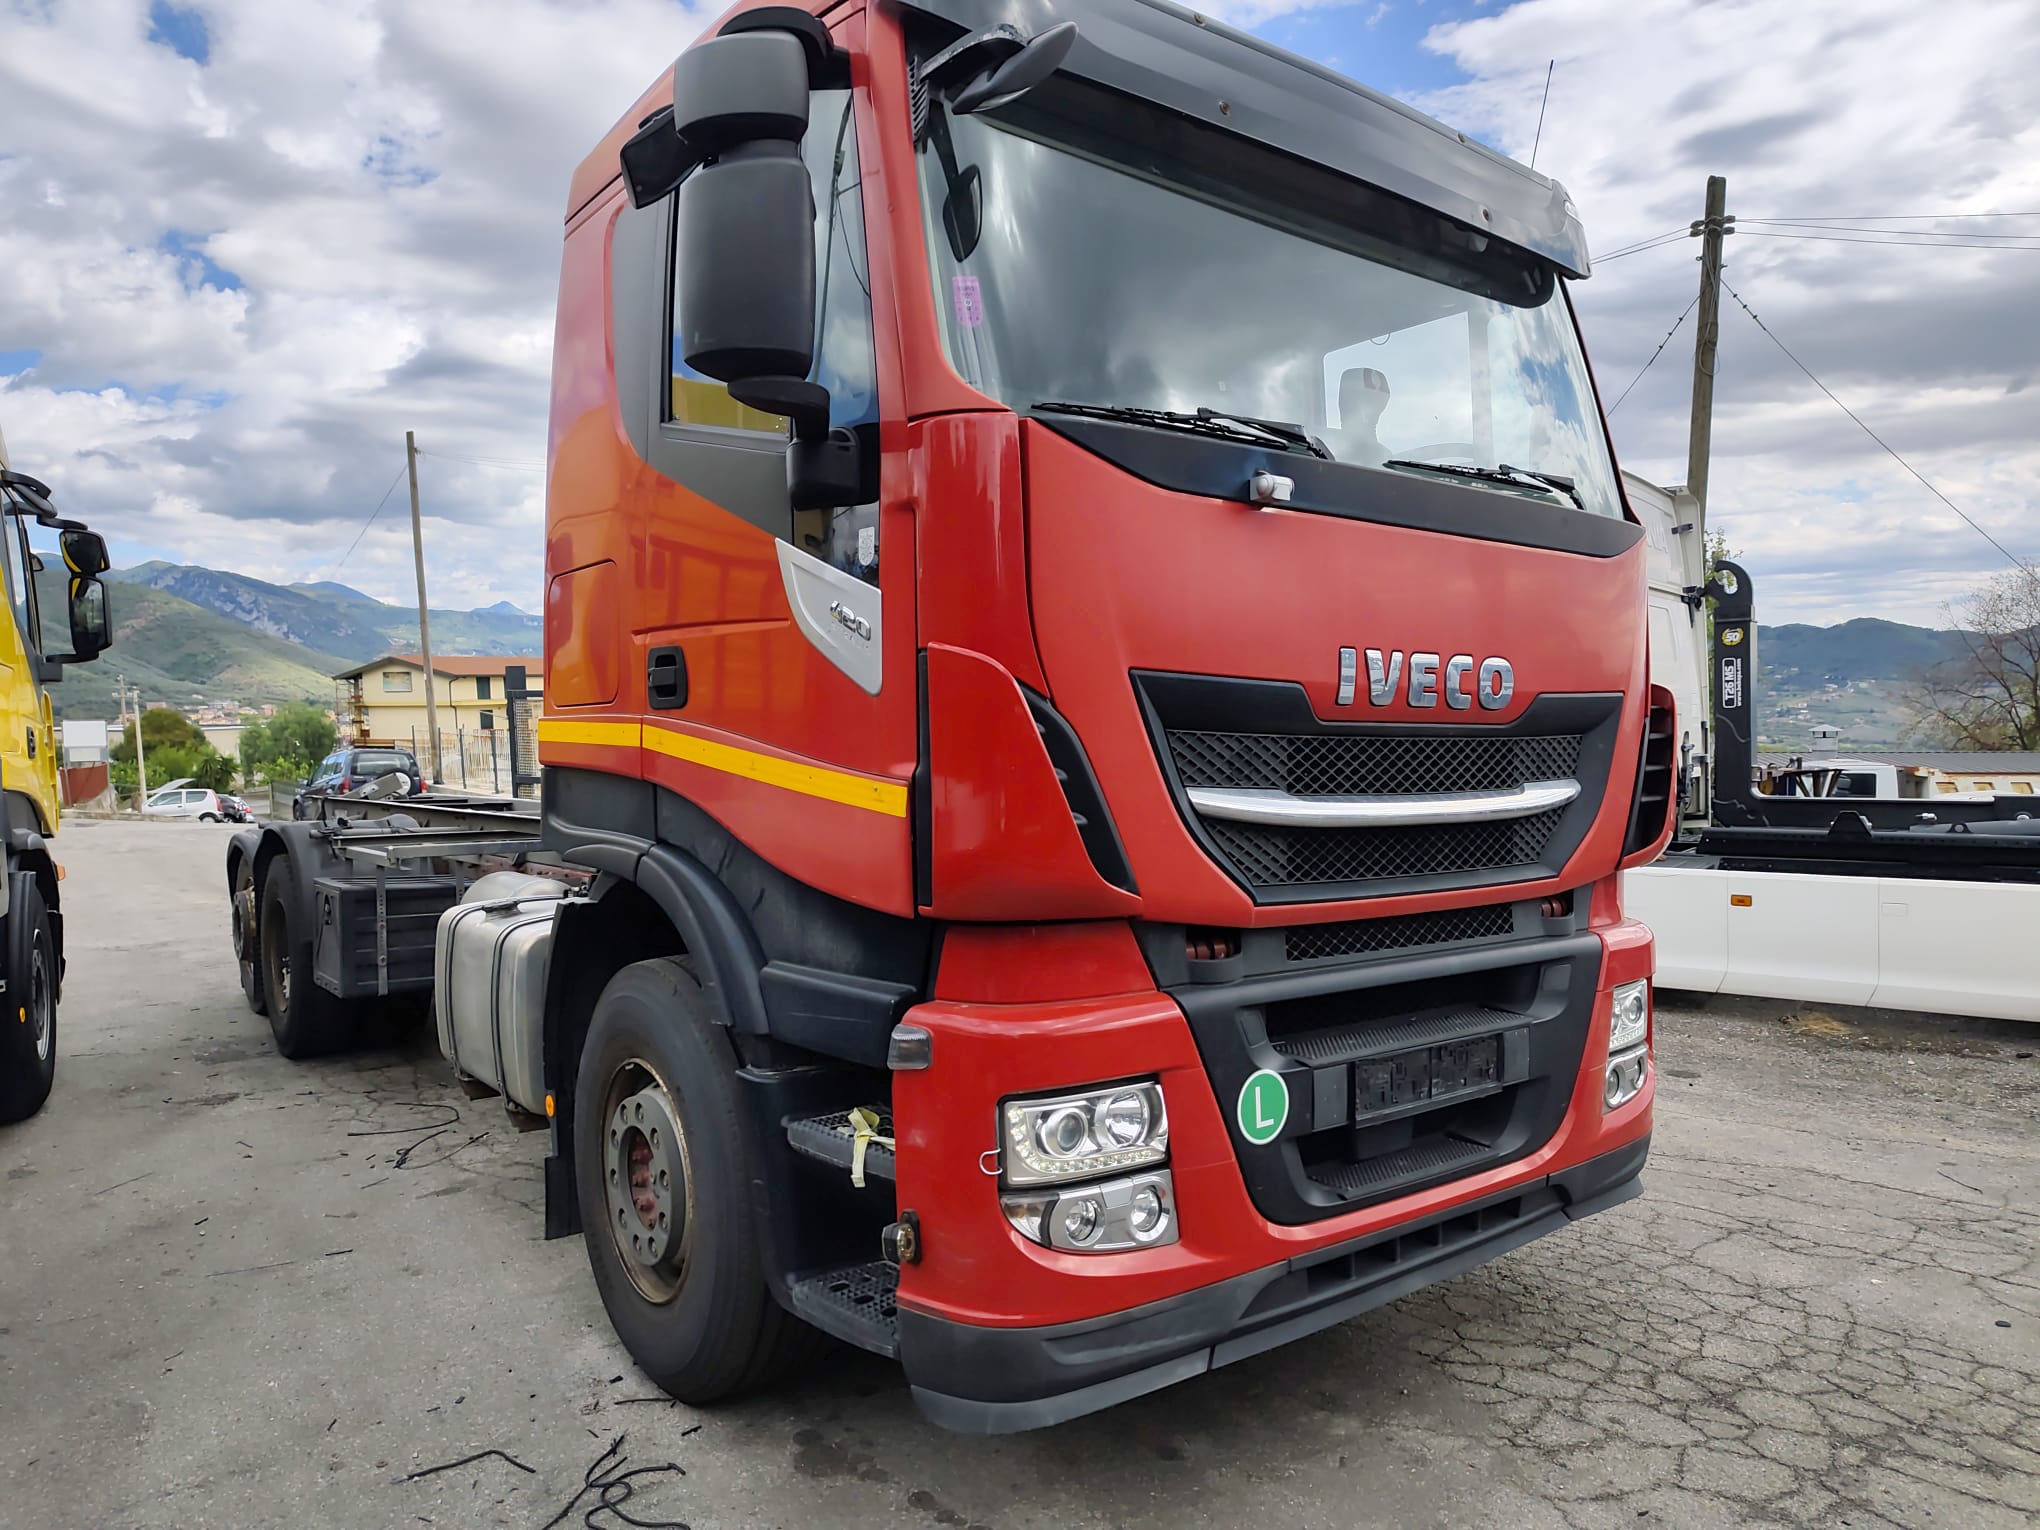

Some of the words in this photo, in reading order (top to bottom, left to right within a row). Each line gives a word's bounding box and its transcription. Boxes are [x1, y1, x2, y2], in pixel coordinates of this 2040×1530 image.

[1337, 647, 1515, 710] IVECO
[1724, 665, 1735, 681] MS
[1724, 682, 1735, 700] T26
[1254, 1086, 1275, 1129] L
